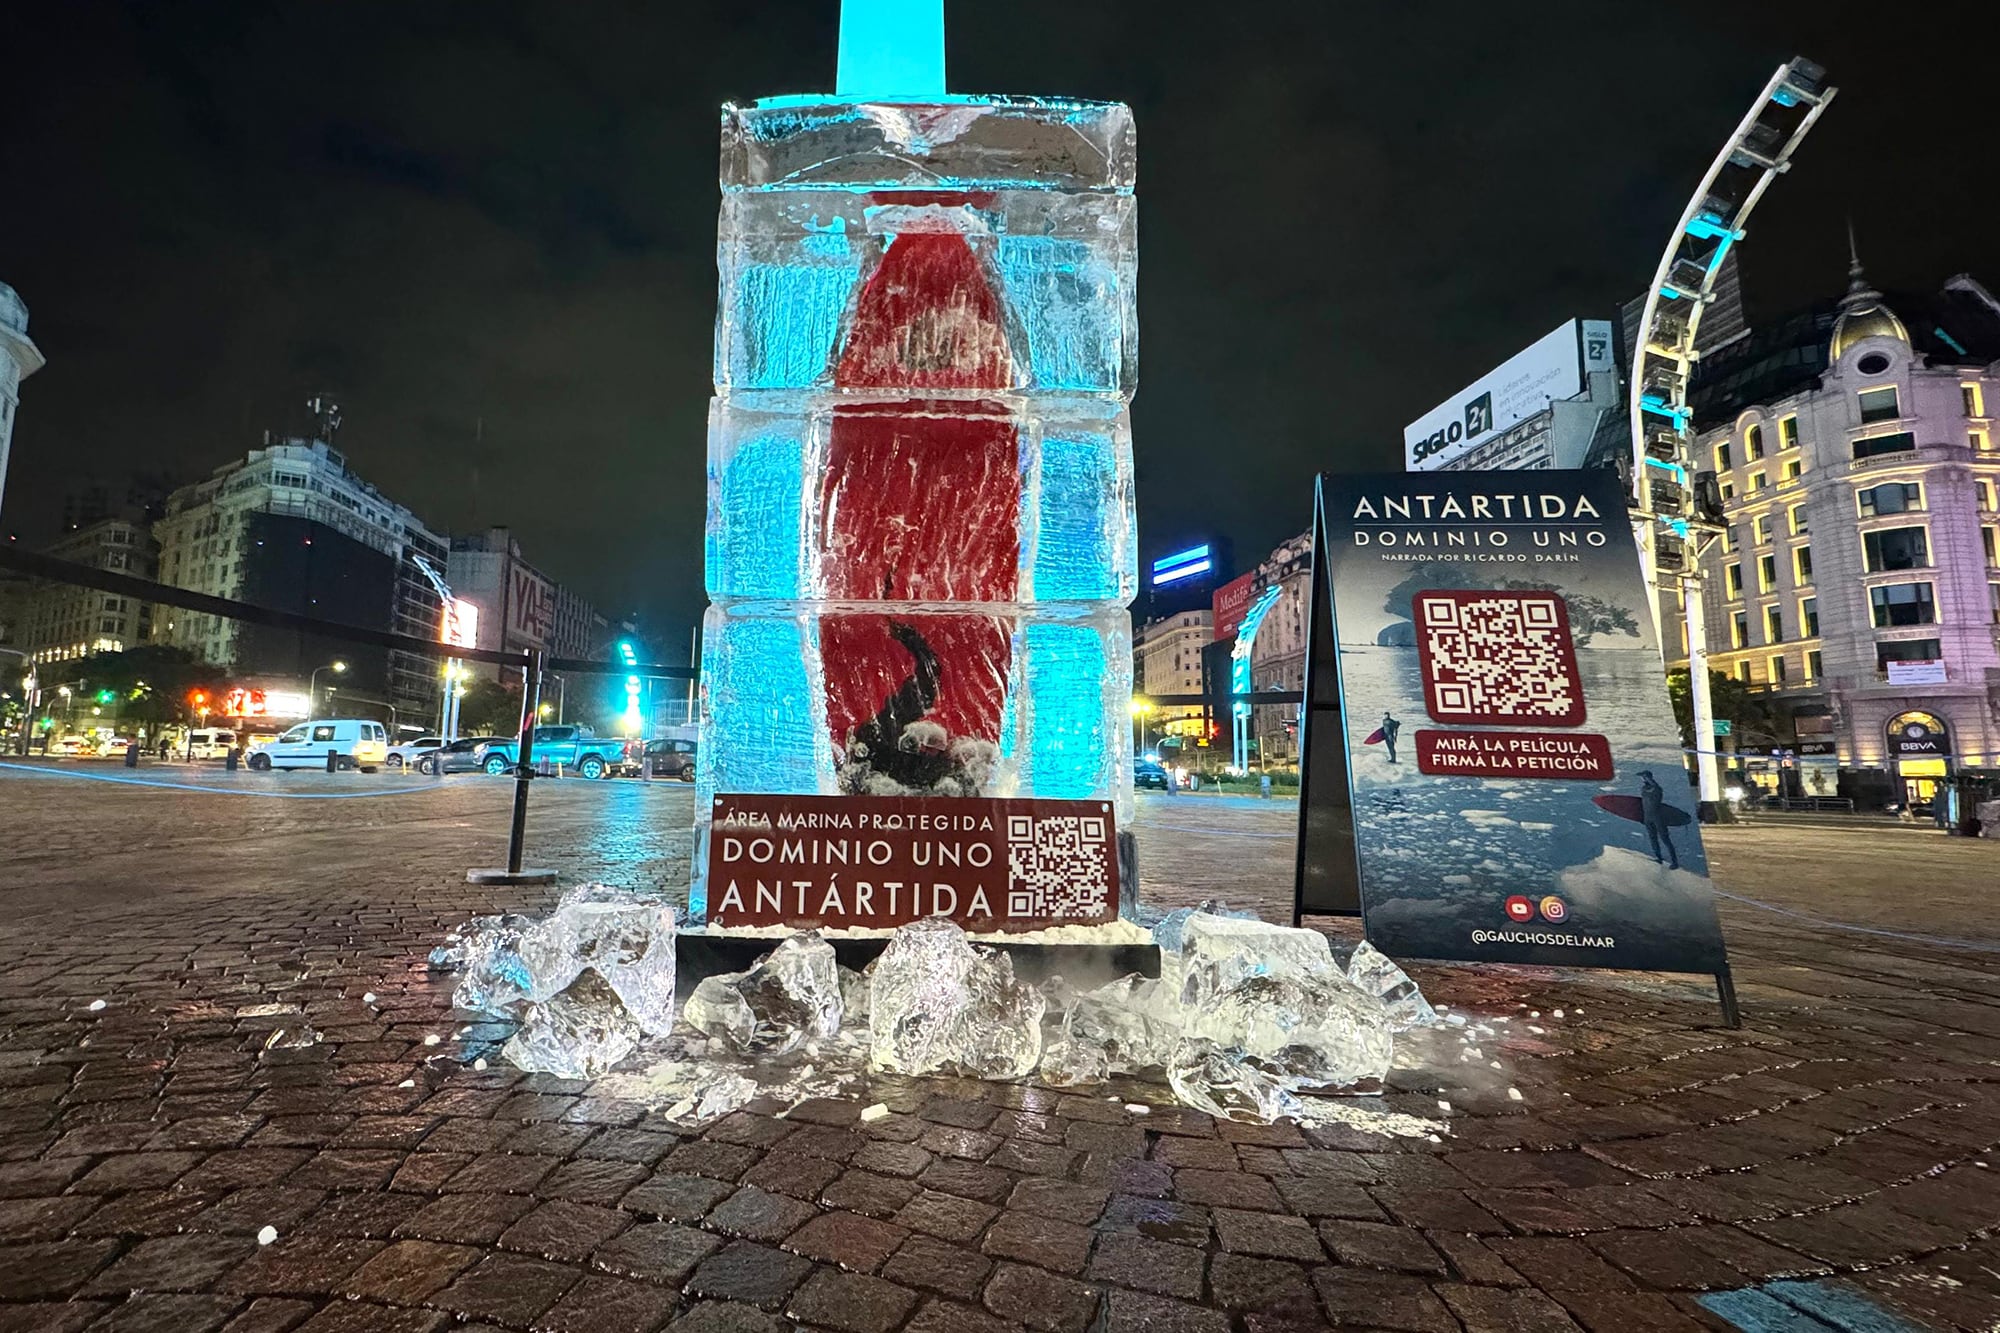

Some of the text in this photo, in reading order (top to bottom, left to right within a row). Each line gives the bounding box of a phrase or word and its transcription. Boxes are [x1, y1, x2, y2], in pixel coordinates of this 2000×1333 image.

[1413, 421, 1462, 464] SIGLO
[1353, 492, 1600, 519] ANTÁRTIDA
[1354, 531, 1606, 547] DOMINIO UNO
[1381, 553, 1579, 562] NARRADA POR RICARDO DARÍN
[1435, 736, 1591, 754] MIRÁ LA PELÍCULA
[1802, 744, 1825, 753] BBVA
[1901, 742, 1937, 750] BBVA
[1432, 752, 1599, 770] FIRMÁ LA PETICIÓN
[724, 807, 994, 831] ÁREA MARINA PROTEGIDA
[723, 838, 992, 868] DOMINIO UNO
[718, 873, 993, 918] ANTÁRTIDA
[1472, 929, 1615, 948] @GAUCHOSDELMAR
